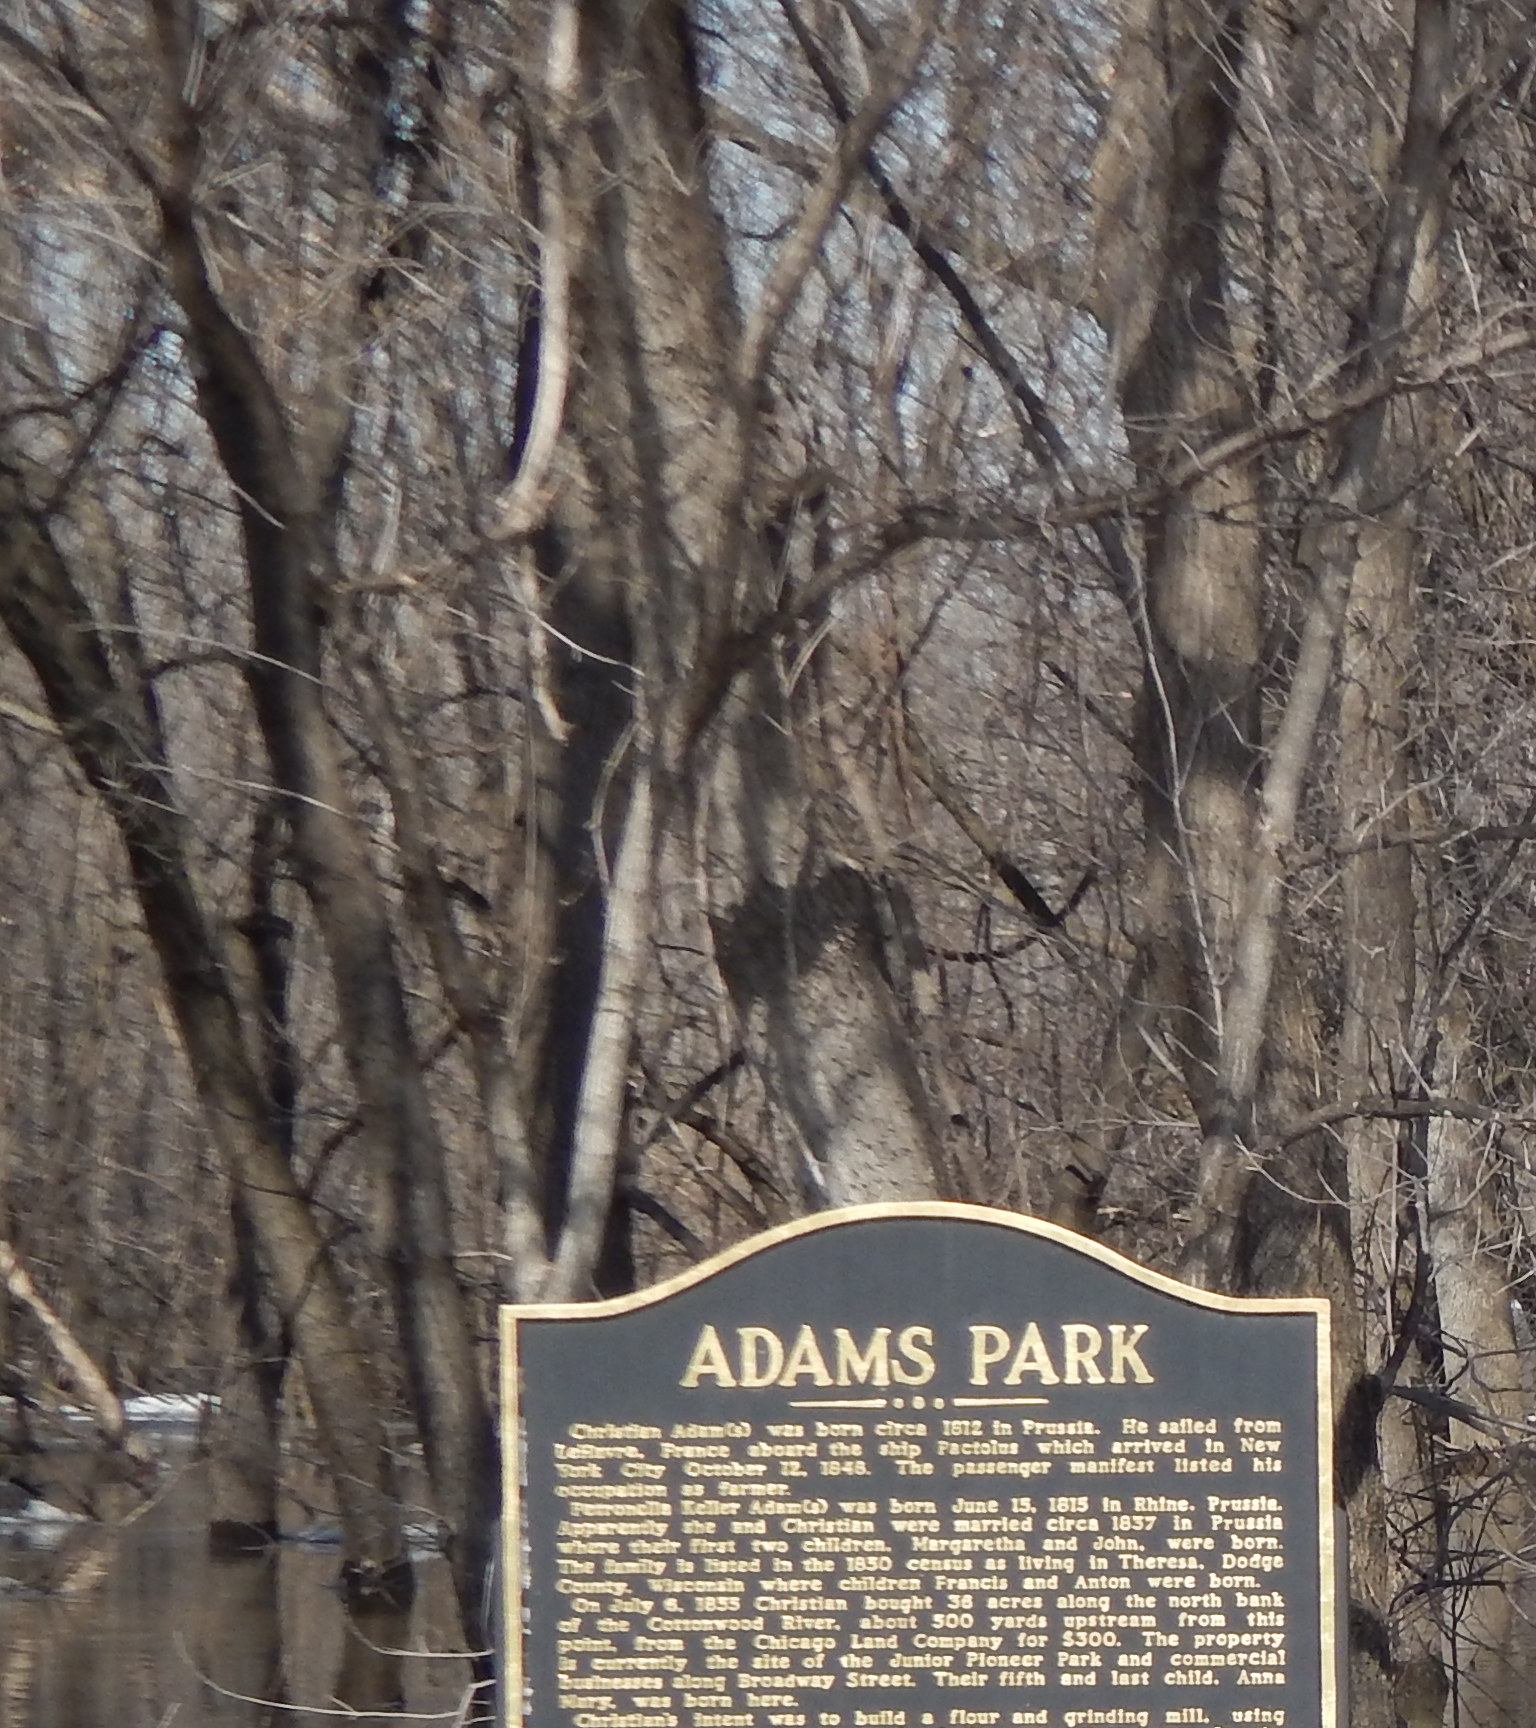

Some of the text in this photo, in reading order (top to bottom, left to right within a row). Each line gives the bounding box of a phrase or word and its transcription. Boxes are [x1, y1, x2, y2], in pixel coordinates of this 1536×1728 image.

[679, 1321, 1155, 1389] ADAMS PARK
[941, 1416, 1282, 1437] 1812 Prussia. sailed from
[937, 1436, 1282, 1456] Pactolus which arrived New
[951, 1456, 1283, 1479] passenger manifest listed his
[951, 1495, 1283, 1514] June 1815 Prussia.
[952, 1513, 1284, 1533] married circa 1837 Prussia
[910, 1533, 1284, 1558] Margaretha and were born.
[905, 1552, 1284, 1574] census living Dodge
[837, 1572, 1261, 1592] children Francis and Anton were born.
[986, 1591, 1286, 1613] acres along the north bank
[989, 1610, 1285, 1634] yards upstream from this
[912, 1633, 1004, 1655] Company
[1141, 1630, 1180, 1647] The
[1193, 1631, 1286, 1652] property
[888, 1646, 1286, 1668] Junior Pioneer Park and commercial
[931, 1668, 1286, 1687] Their fifth and last Anna
[949, 1707, 1285, 1728] flour grinding using
